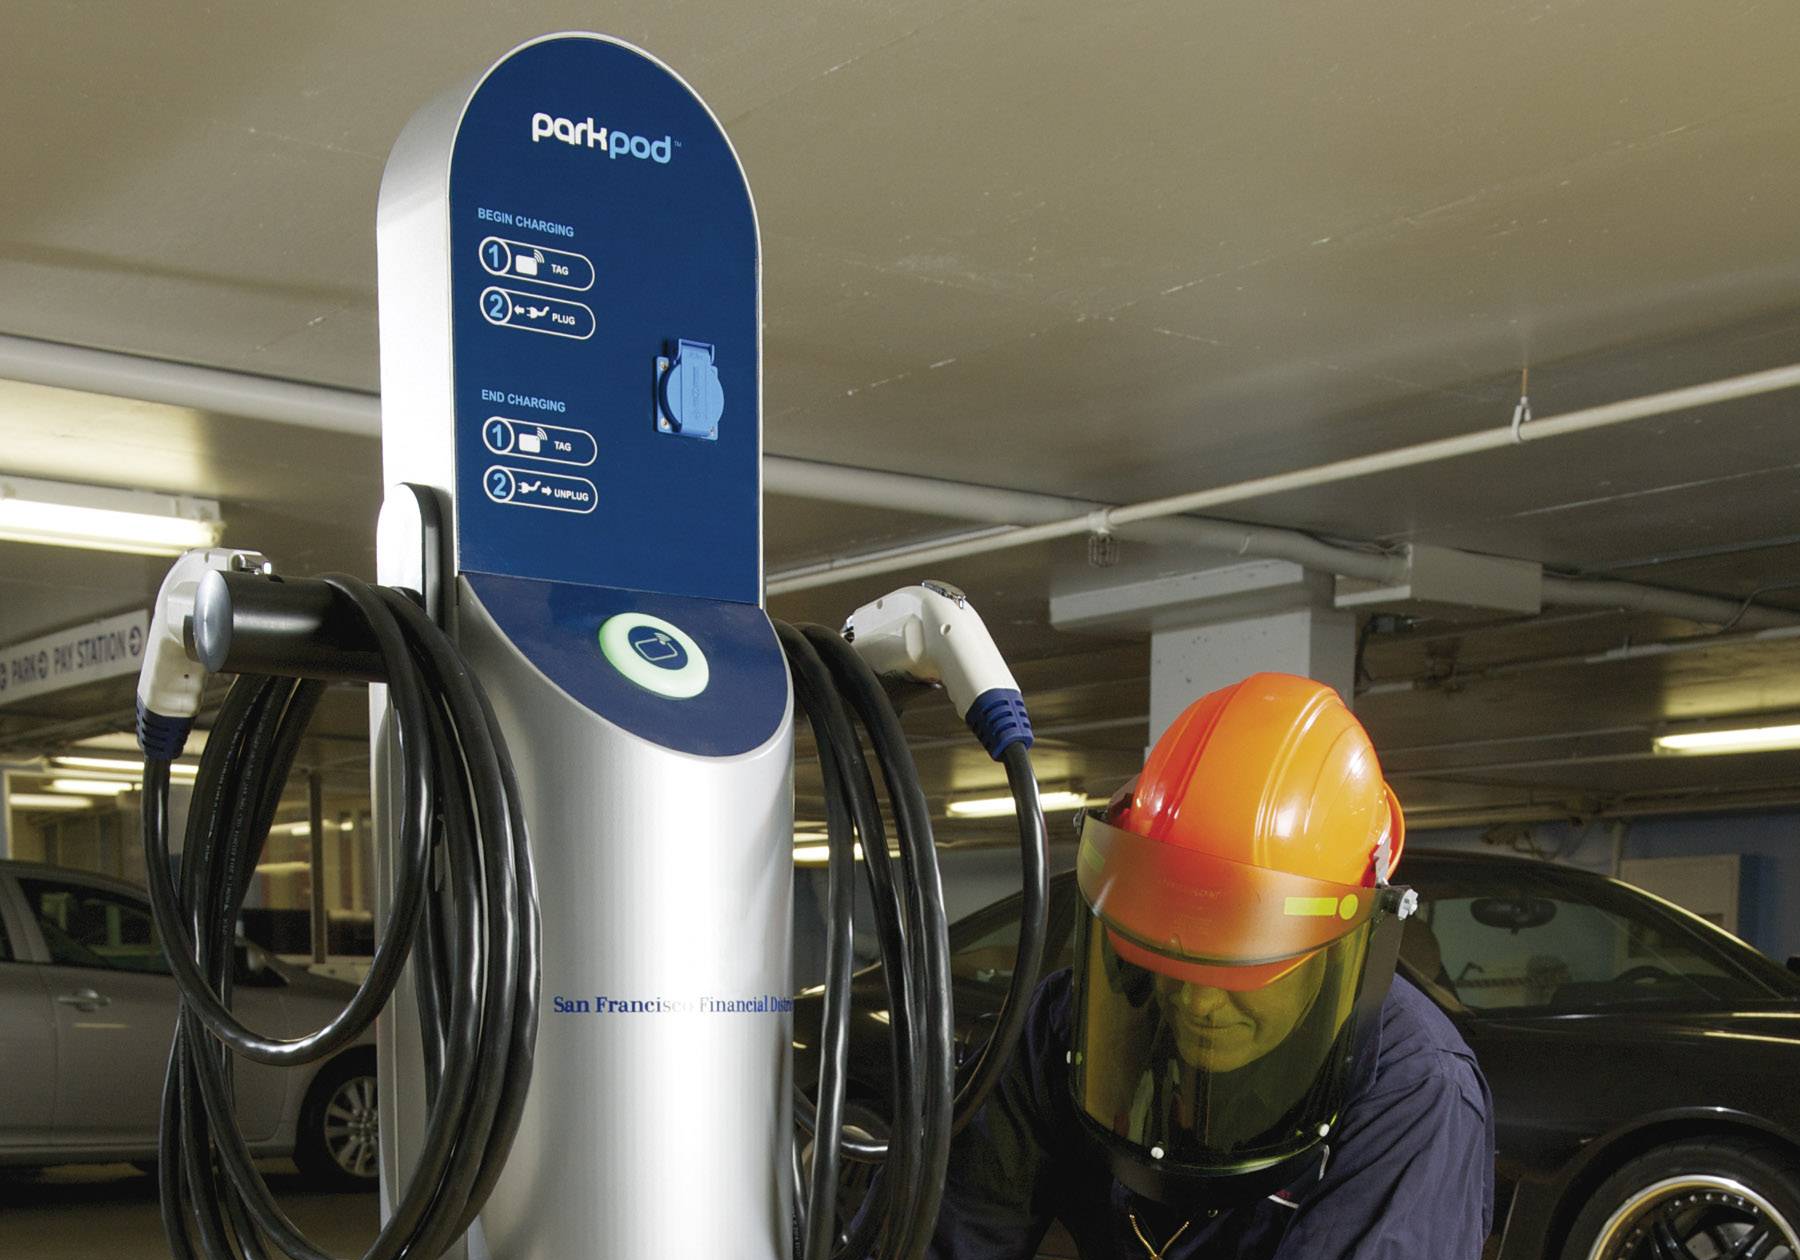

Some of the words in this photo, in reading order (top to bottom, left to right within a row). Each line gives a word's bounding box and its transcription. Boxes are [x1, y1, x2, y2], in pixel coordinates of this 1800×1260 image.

[532, 112, 672, 164] parkpod
[477, 207, 513, 226] BEGIN
[515, 215, 575, 238] CHARGING
[488, 244, 499, 268] 1
[551, 263, 569, 276] TAG
[489, 294, 503, 318] 2
[551, 312, 576, 326] PLUG
[481, 389, 505, 403] END
[507, 394, 566, 413] CHARGING
[492, 424, 503, 447] 1
[554, 440, 572, 452] TAG
[493, 472, 507, 496] 2
[553, 488, 589, 502] UNPLUG
[78, 630, 127, 668] STATION
[553, 996, 590, 1013] San
[700, 995, 769, 1013] Financial
